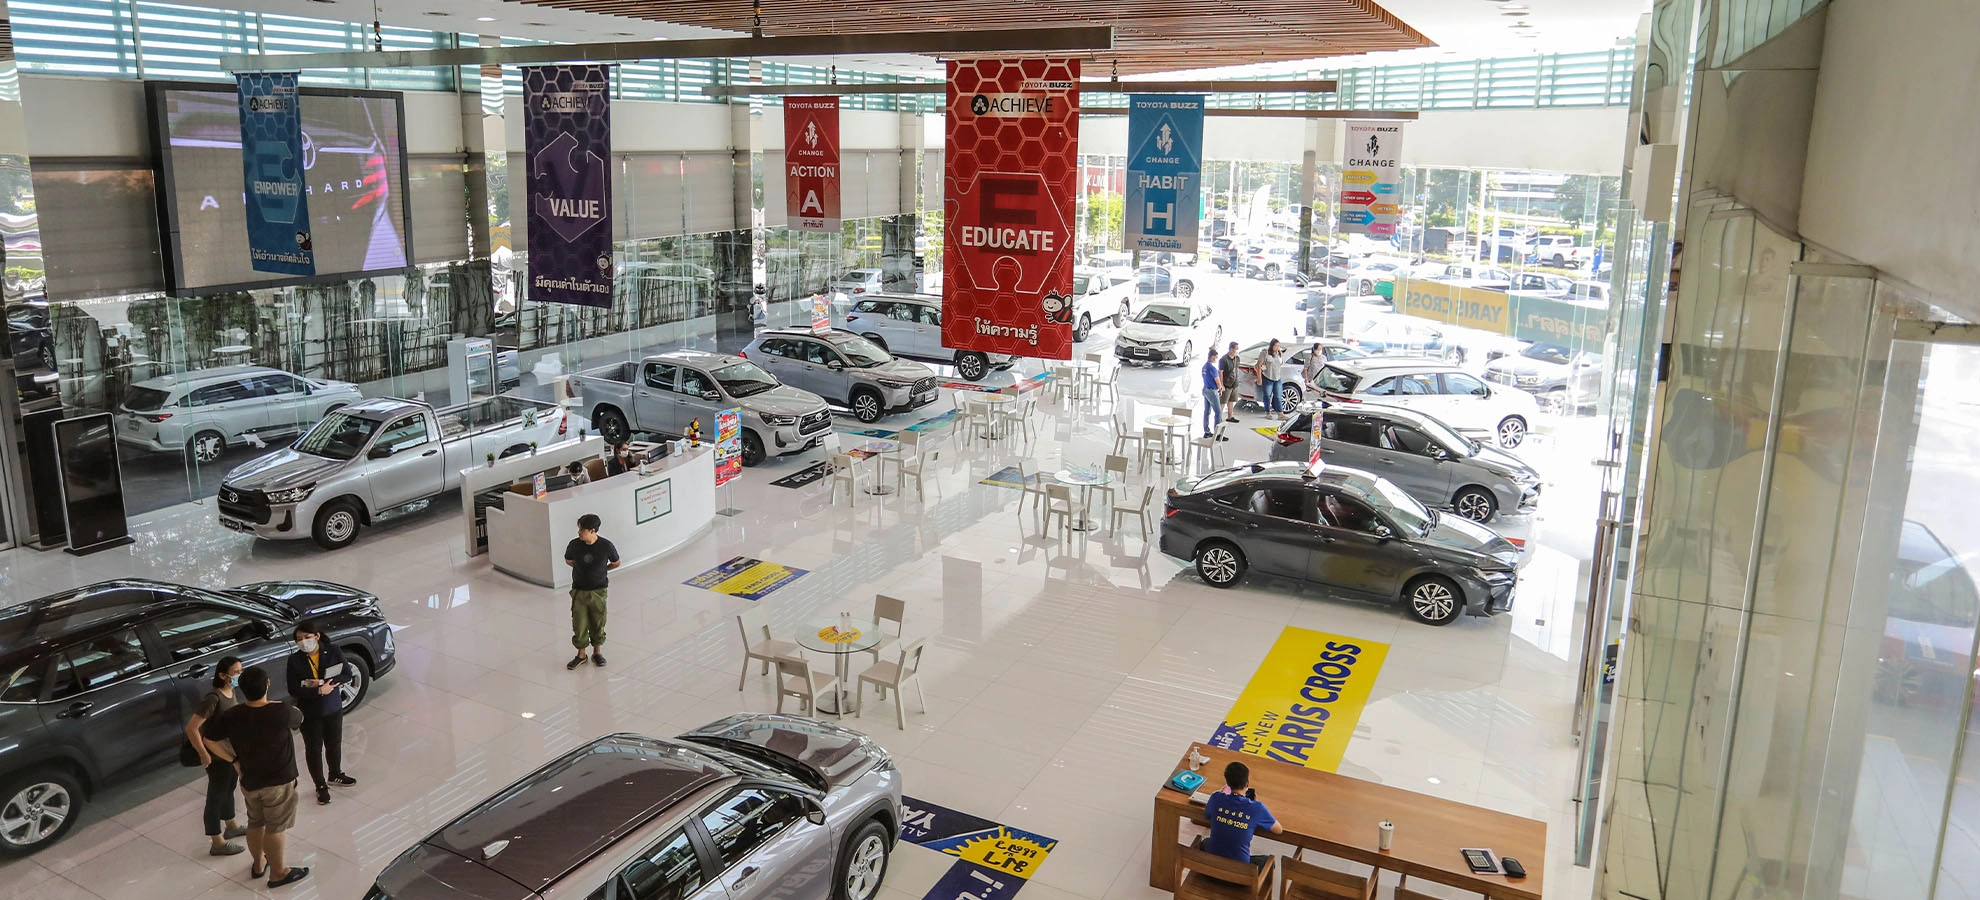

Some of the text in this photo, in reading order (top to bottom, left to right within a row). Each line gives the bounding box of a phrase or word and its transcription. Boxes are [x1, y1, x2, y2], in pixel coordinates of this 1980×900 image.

[258, 99, 288, 110] ACHIEVE
[990, 98, 1053, 113] ACHIEVE
[1146, 156, 1180, 164] CHANGE
[1349, 158, 1395, 167] CHANGE
[790, 166, 835, 178] ACTION
[253, 181, 298, 197] EMPOWER
[1138, 175, 1189, 190] HABIT
[550, 198, 600, 219] VALUE
[800, 189, 823, 214] A
[1146, 201, 1174, 231] H
[961, 226, 1054, 251] EDUCATE
[535, 275, 610, 294] มีคุณค่าในตัวเอง
[974, 316, 1038, 345] ให้ความรู้
[1299, 641, 1362, 703] CROSS
[994, 840, 1038, 859] แล้ว
[982, 851, 1029, 873] มา
